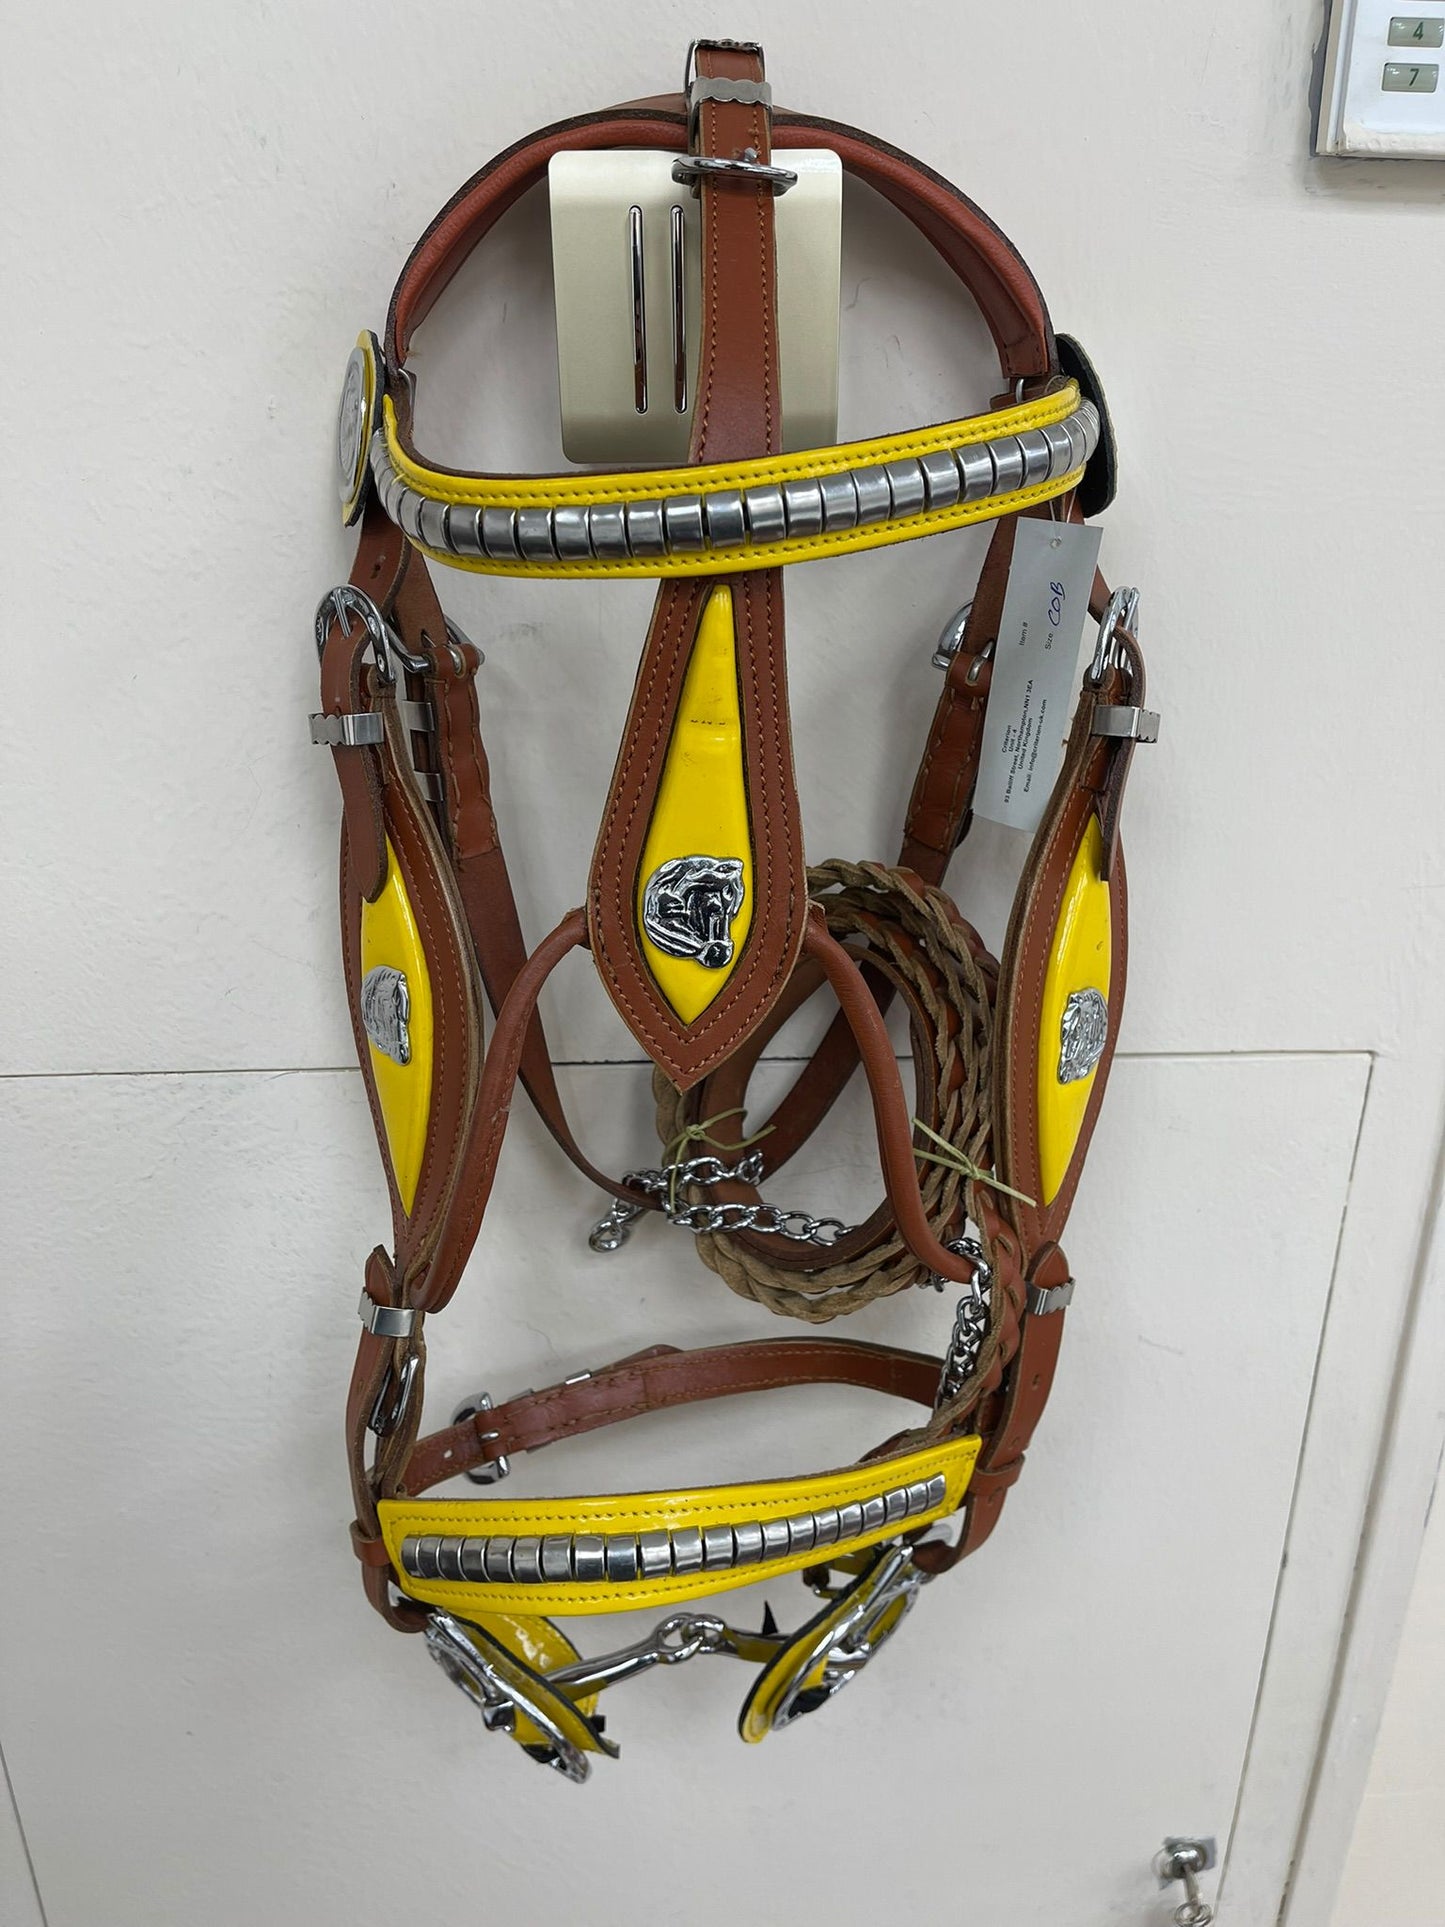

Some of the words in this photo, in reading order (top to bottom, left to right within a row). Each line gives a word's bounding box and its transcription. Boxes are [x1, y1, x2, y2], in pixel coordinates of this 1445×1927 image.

[1412, 21, 1424, 41] 4
[1408, 67, 1419, 87] 7
[1048, 581, 1066, 626] COB
[1002, 725, 1011, 753] Criterion
[1018, 748, 1026, 770] United
[1022, 717, 1033, 747] Kingdom
